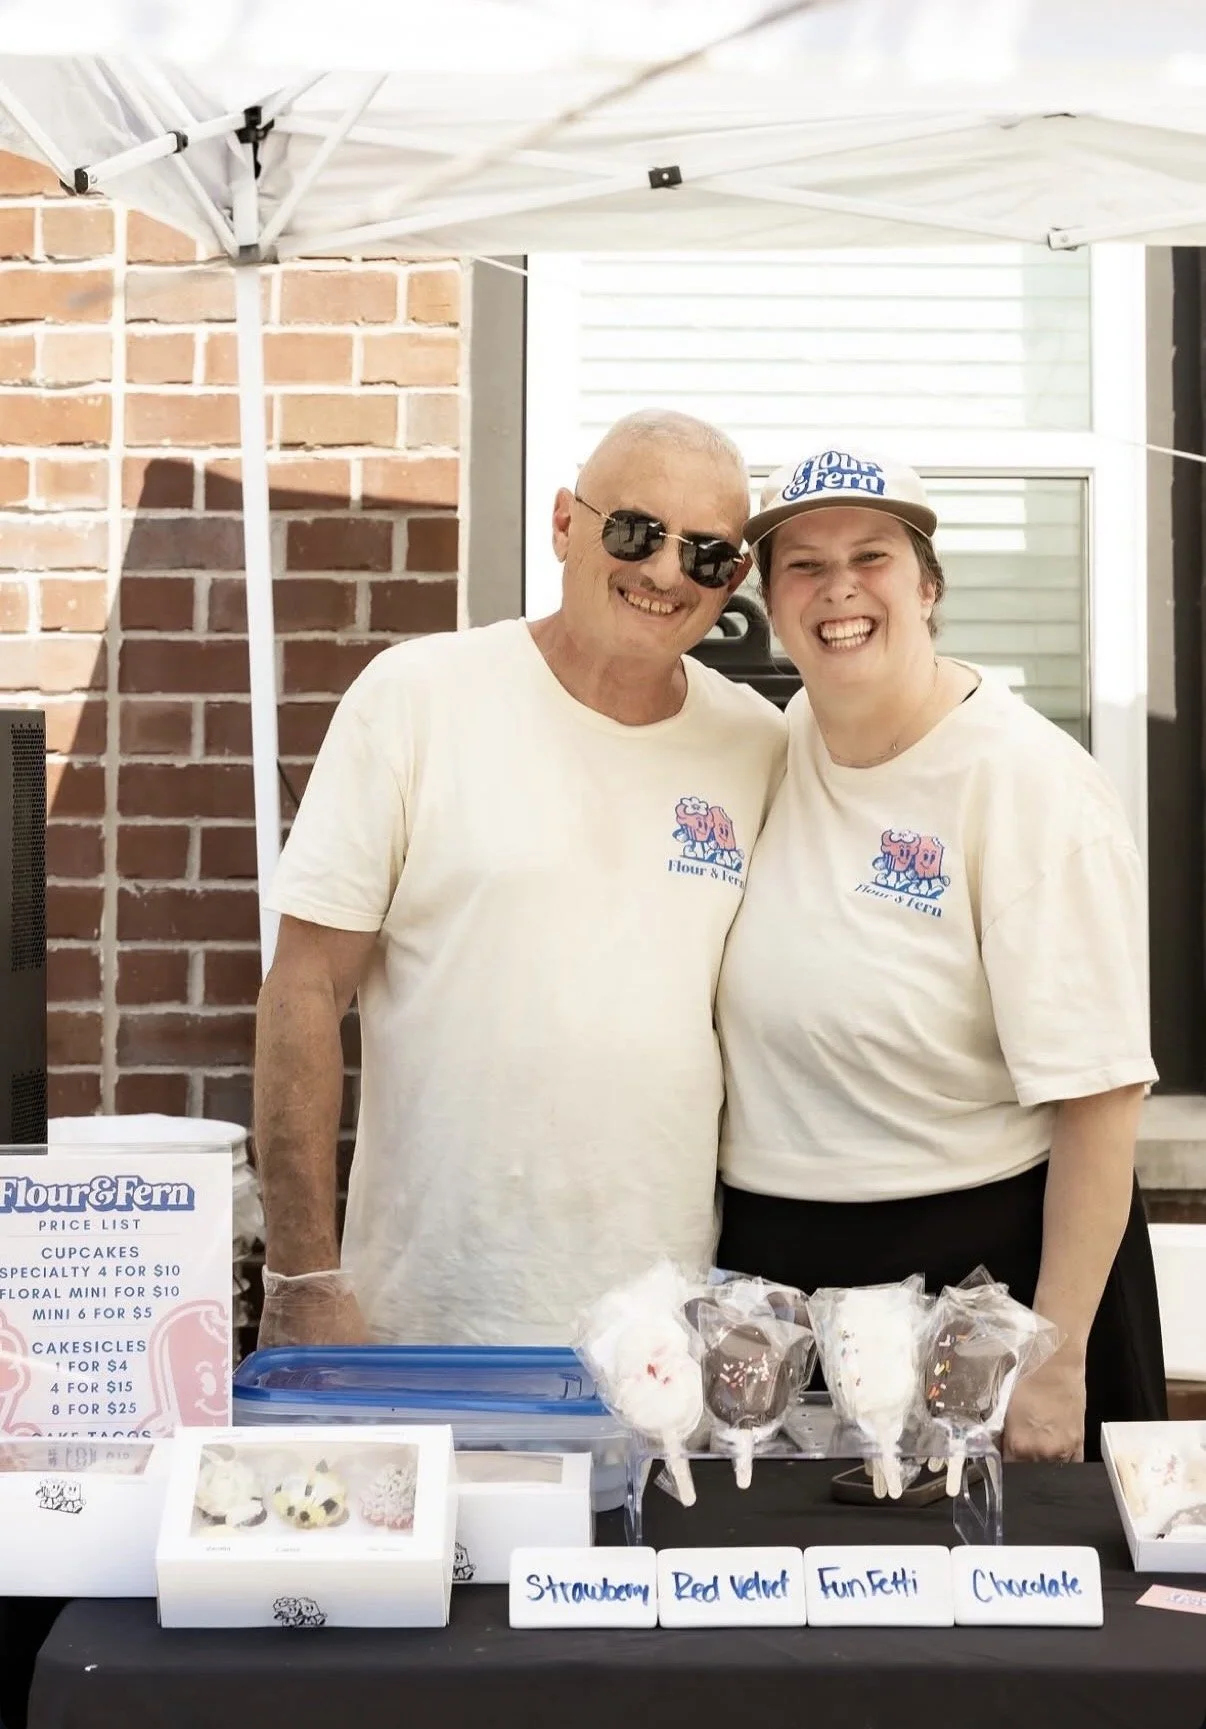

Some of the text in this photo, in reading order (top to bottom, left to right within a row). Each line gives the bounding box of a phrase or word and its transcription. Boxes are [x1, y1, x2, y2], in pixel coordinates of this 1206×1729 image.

[668, 859, 707, 876] Flour
[711, 867, 718, 879] &
[907, 897, 942, 917] Fern
[0, 1175, 195, 1213] Flour&Fern
[39, 1218, 142, 1231] PRICE LIST
[41, 1246, 140, 1260] CUPCAKES
[0, 1263, 180, 1279] SPECIALTY 4 FOR $10
[0, 1285, 180, 1300] FLORAL MINI FOR $10
[32, 1305, 153, 1321] MINI 6 FOR $5
[31, 1340, 147, 1355] CAKESICLES
[68, 1360, 100, 1372] FOR
[107, 1359, 128, 1373] $4
[50, 1380, 133, 1394] 4 FOR $15
[51, 1402, 137, 1416] 8 FOR $25
[671, 1571, 720, 1603] Red
